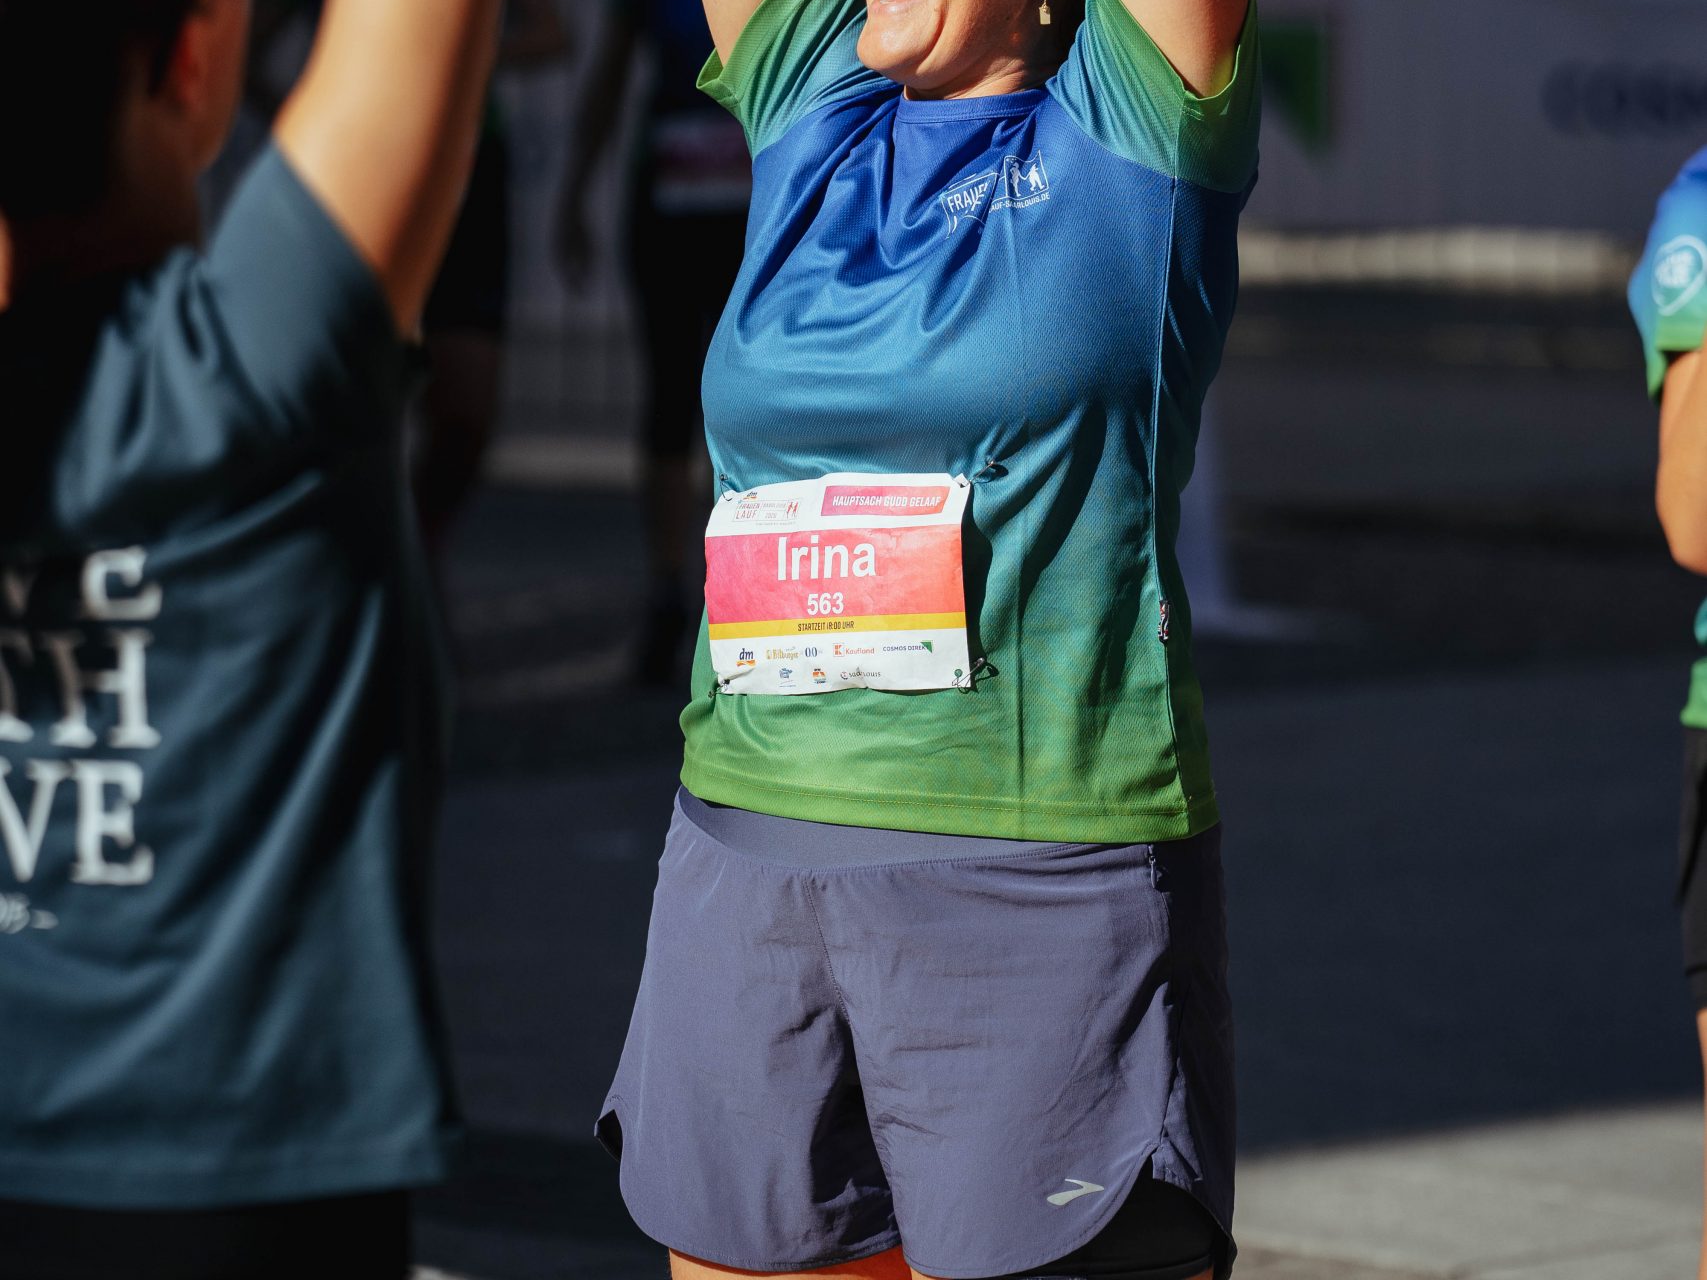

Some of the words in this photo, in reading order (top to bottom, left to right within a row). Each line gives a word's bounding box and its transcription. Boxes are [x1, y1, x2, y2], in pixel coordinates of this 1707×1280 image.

[832, 495, 881, 507] HAUPTSACH
[883, 495, 908, 507] GUDD
[909, 496, 941, 507] GELAAF
[778, 534, 876, 581] Irina
[807, 591, 844, 616] 563
[797, 622, 826, 632] STARTZEIT
[842, 620, 855, 630] UHR
[739, 647, 754, 661] dm
[0, 756, 154, 886] VE
